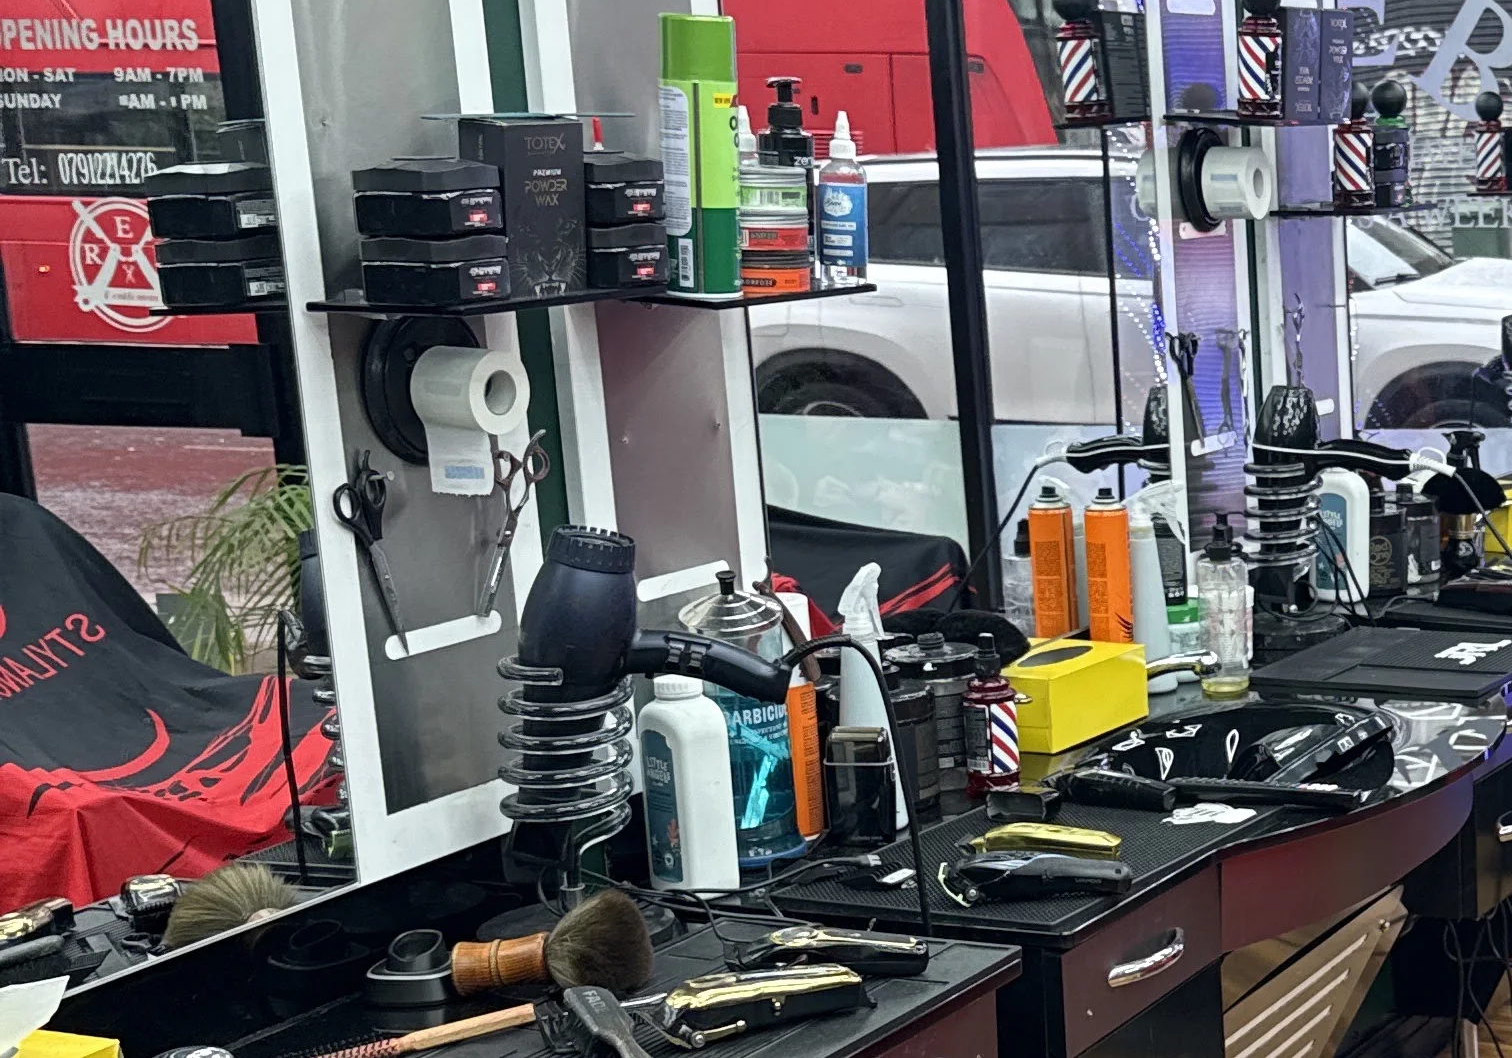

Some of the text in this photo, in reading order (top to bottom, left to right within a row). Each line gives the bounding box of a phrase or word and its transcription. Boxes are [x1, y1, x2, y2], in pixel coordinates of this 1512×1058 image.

[0, 18, 199, 51] PENING HOURS
[0, 67, 29, 83] ON
[43, 67, 76, 83] SAT
[114, 67, 151, 83] 9AM
[165, 67, 204, 83] 7PM
[524, 133, 566, 154] TOTEX
[1, 157, 48, 185] Tel:
[524, 178, 568, 193] POWDER
[534, 192, 560, 207] WAX
[729, 703, 787, 726] ARBICID
